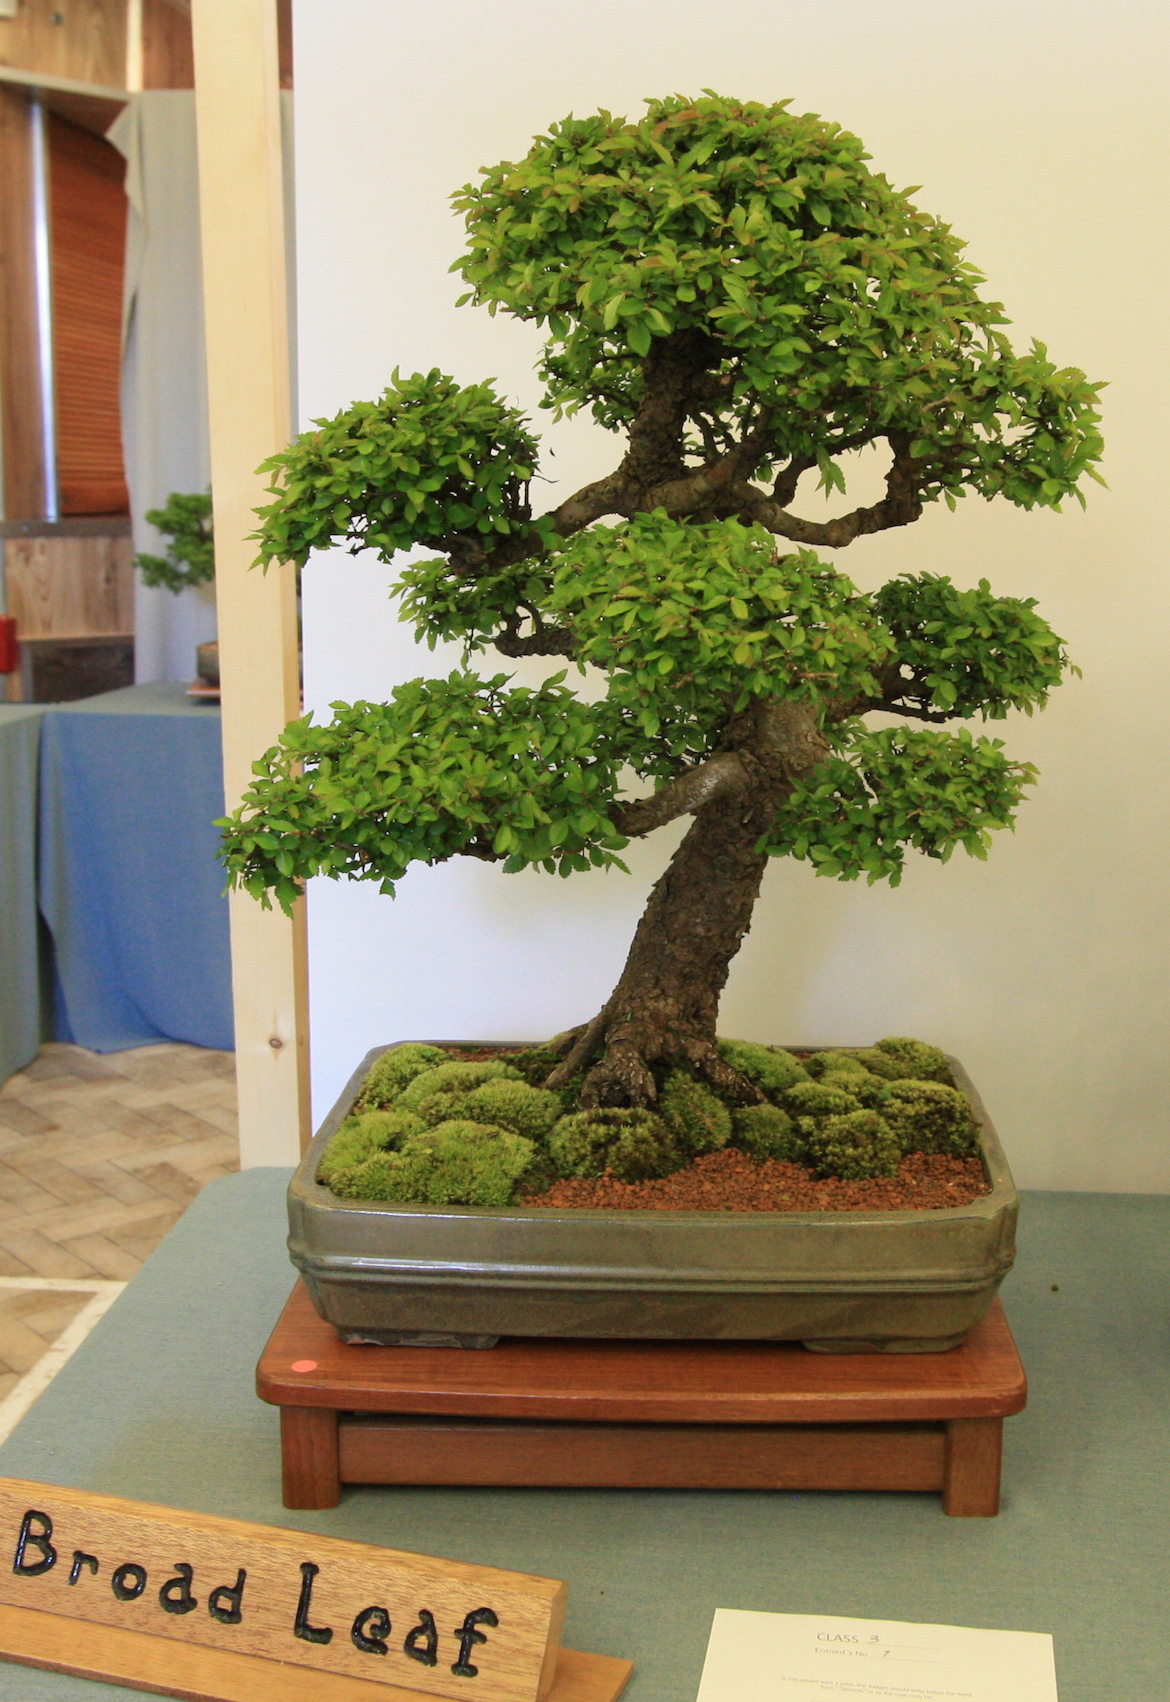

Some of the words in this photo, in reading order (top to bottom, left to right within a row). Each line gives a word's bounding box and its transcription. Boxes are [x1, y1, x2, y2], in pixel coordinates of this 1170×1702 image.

[13, 1509, 247, 1625] Broad
[293, 1562, 499, 1677] Leaf
[816, 1632, 859, 1643] CLASS
[868, 1634, 880, 1644] 3
